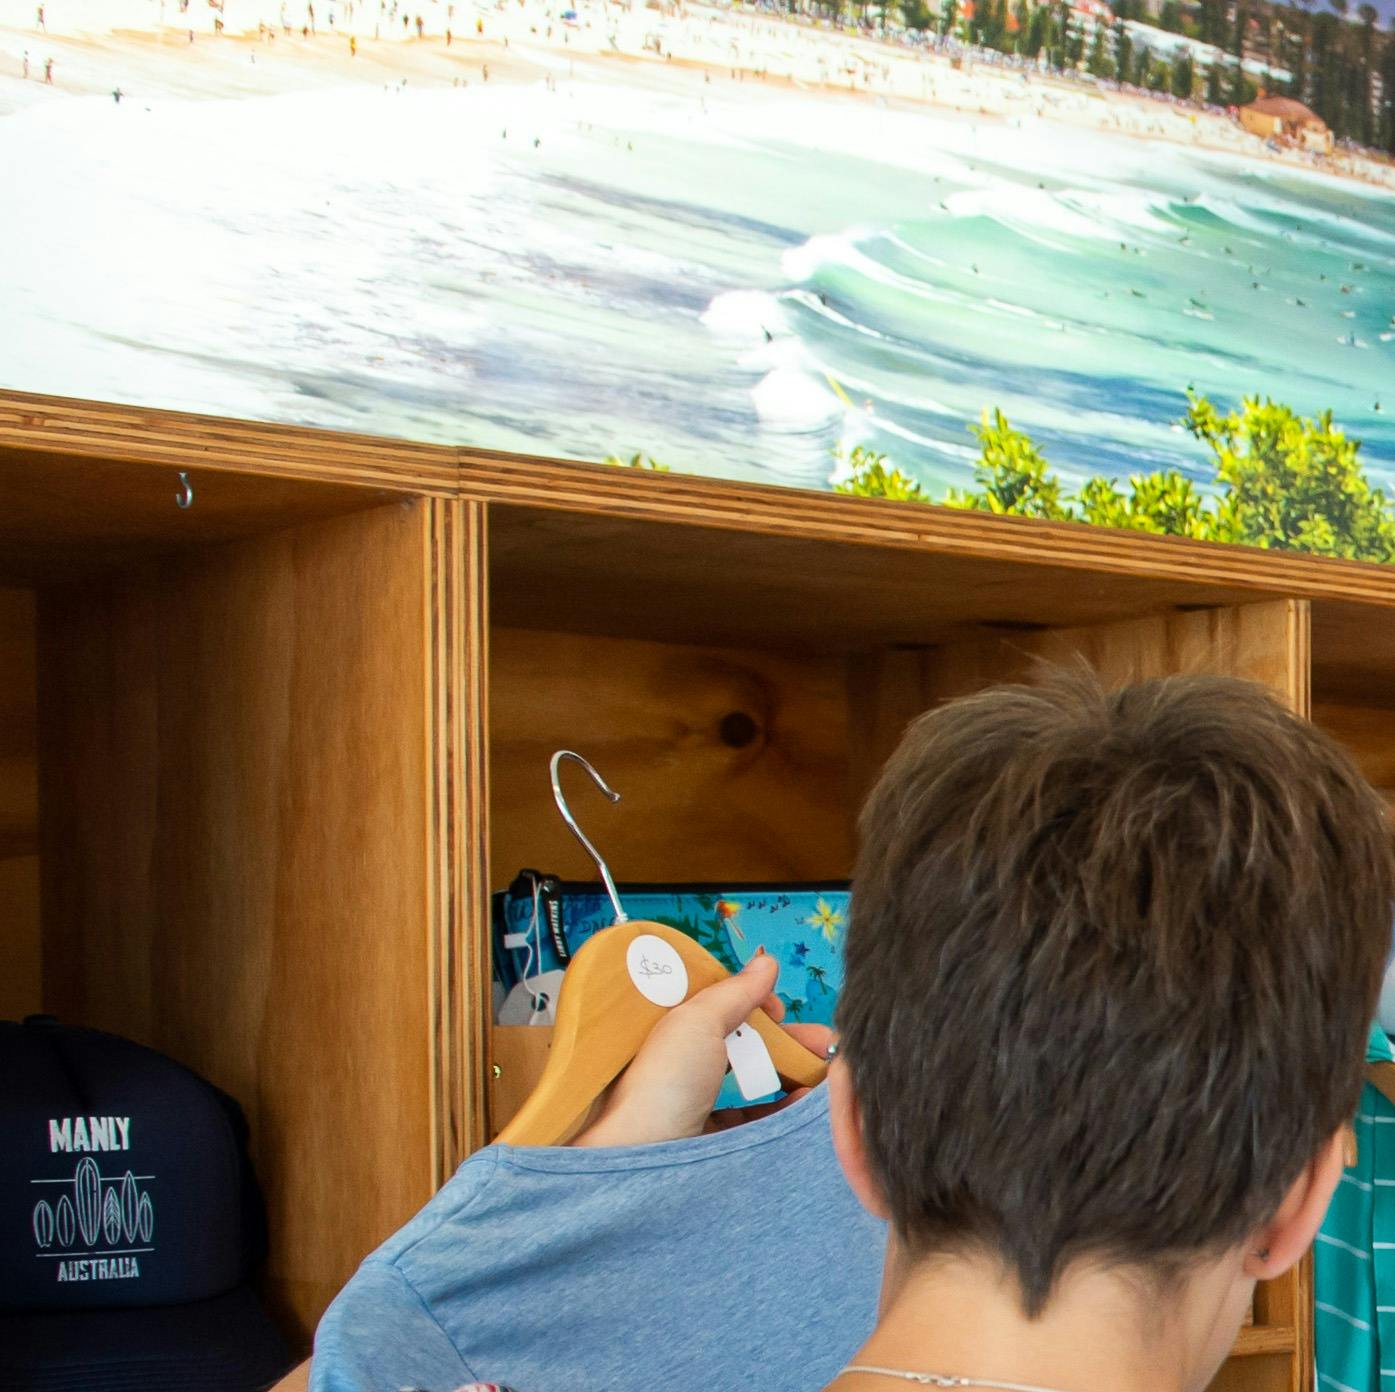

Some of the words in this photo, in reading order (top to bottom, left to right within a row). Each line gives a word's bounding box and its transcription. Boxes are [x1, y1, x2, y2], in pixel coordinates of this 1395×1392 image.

[639, 954, 673, 980] $30
[49, 1116, 131, 1153] MANLY
[57, 1258, 140, 1282] AUSTRALIA
